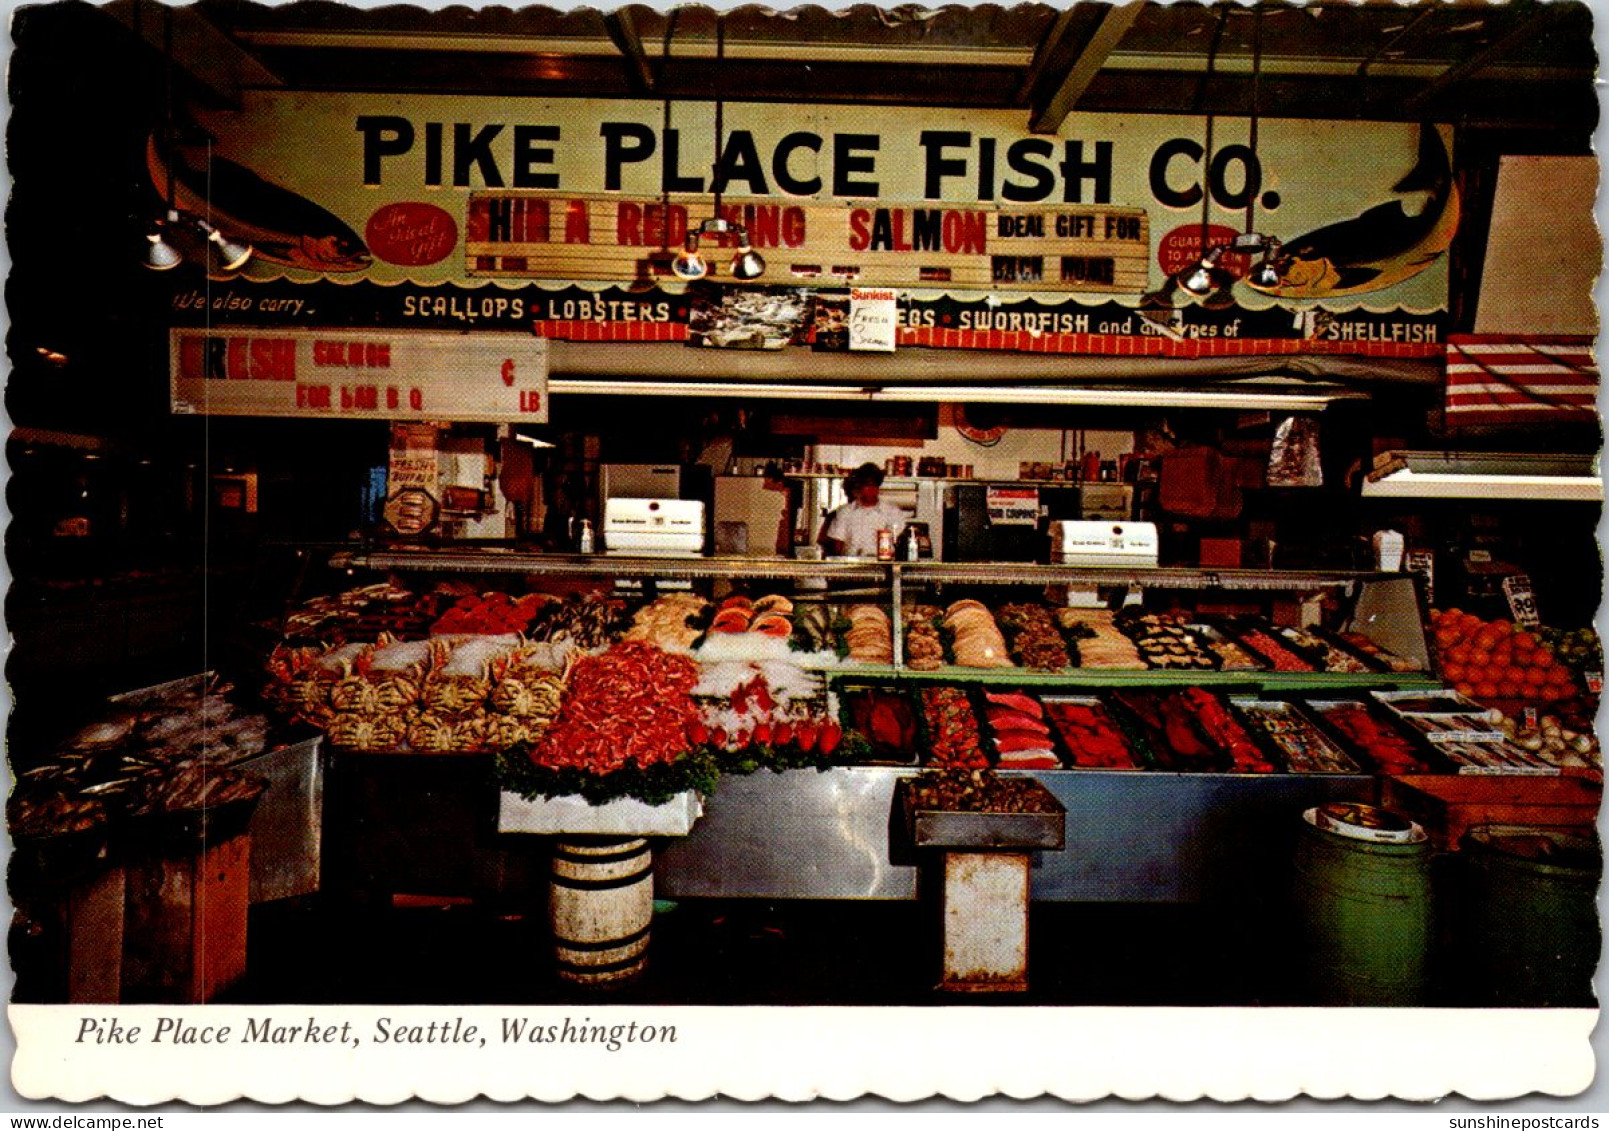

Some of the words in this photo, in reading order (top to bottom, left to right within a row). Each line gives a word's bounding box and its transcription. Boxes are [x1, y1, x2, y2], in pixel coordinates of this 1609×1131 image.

[356, 116, 560, 190] PIKE
[600, 121, 881, 197] PLACE
[919, 129, 1114, 205] FISH
[1148, 136, 1282, 210] CO.
[565, 198, 590, 245] A
[617, 201, 688, 247] RED
[720, 204, 806, 249] KING
[849, 207, 987, 255] SALMON
[997, 214, 1045, 238] IDEAL
[1056, 215, 1095, 239] GIFT
[1104, 216, 1141, 240] FOR
[213, 291, 252, 309] also
[259, 298, 305, 316] carry
[851, 288, 893, 301] Sunkist
[403, 296, 525, 320] SCALLOPS
[549, 299, 670, 322] LOBSTERS
[959, 310, 1089, 333] SWORDFISH
[1099, 316, 1132, 335] and
[1223, 317, 1242, 338] of
[1327, 320, 1437, 344] SHELLFISH
[180, 337, 296, 381] FRESH
[296, 384, 331, 410] FOR
[410, 387, 423, 412] Q
[519, 390, 541, 413] LB
